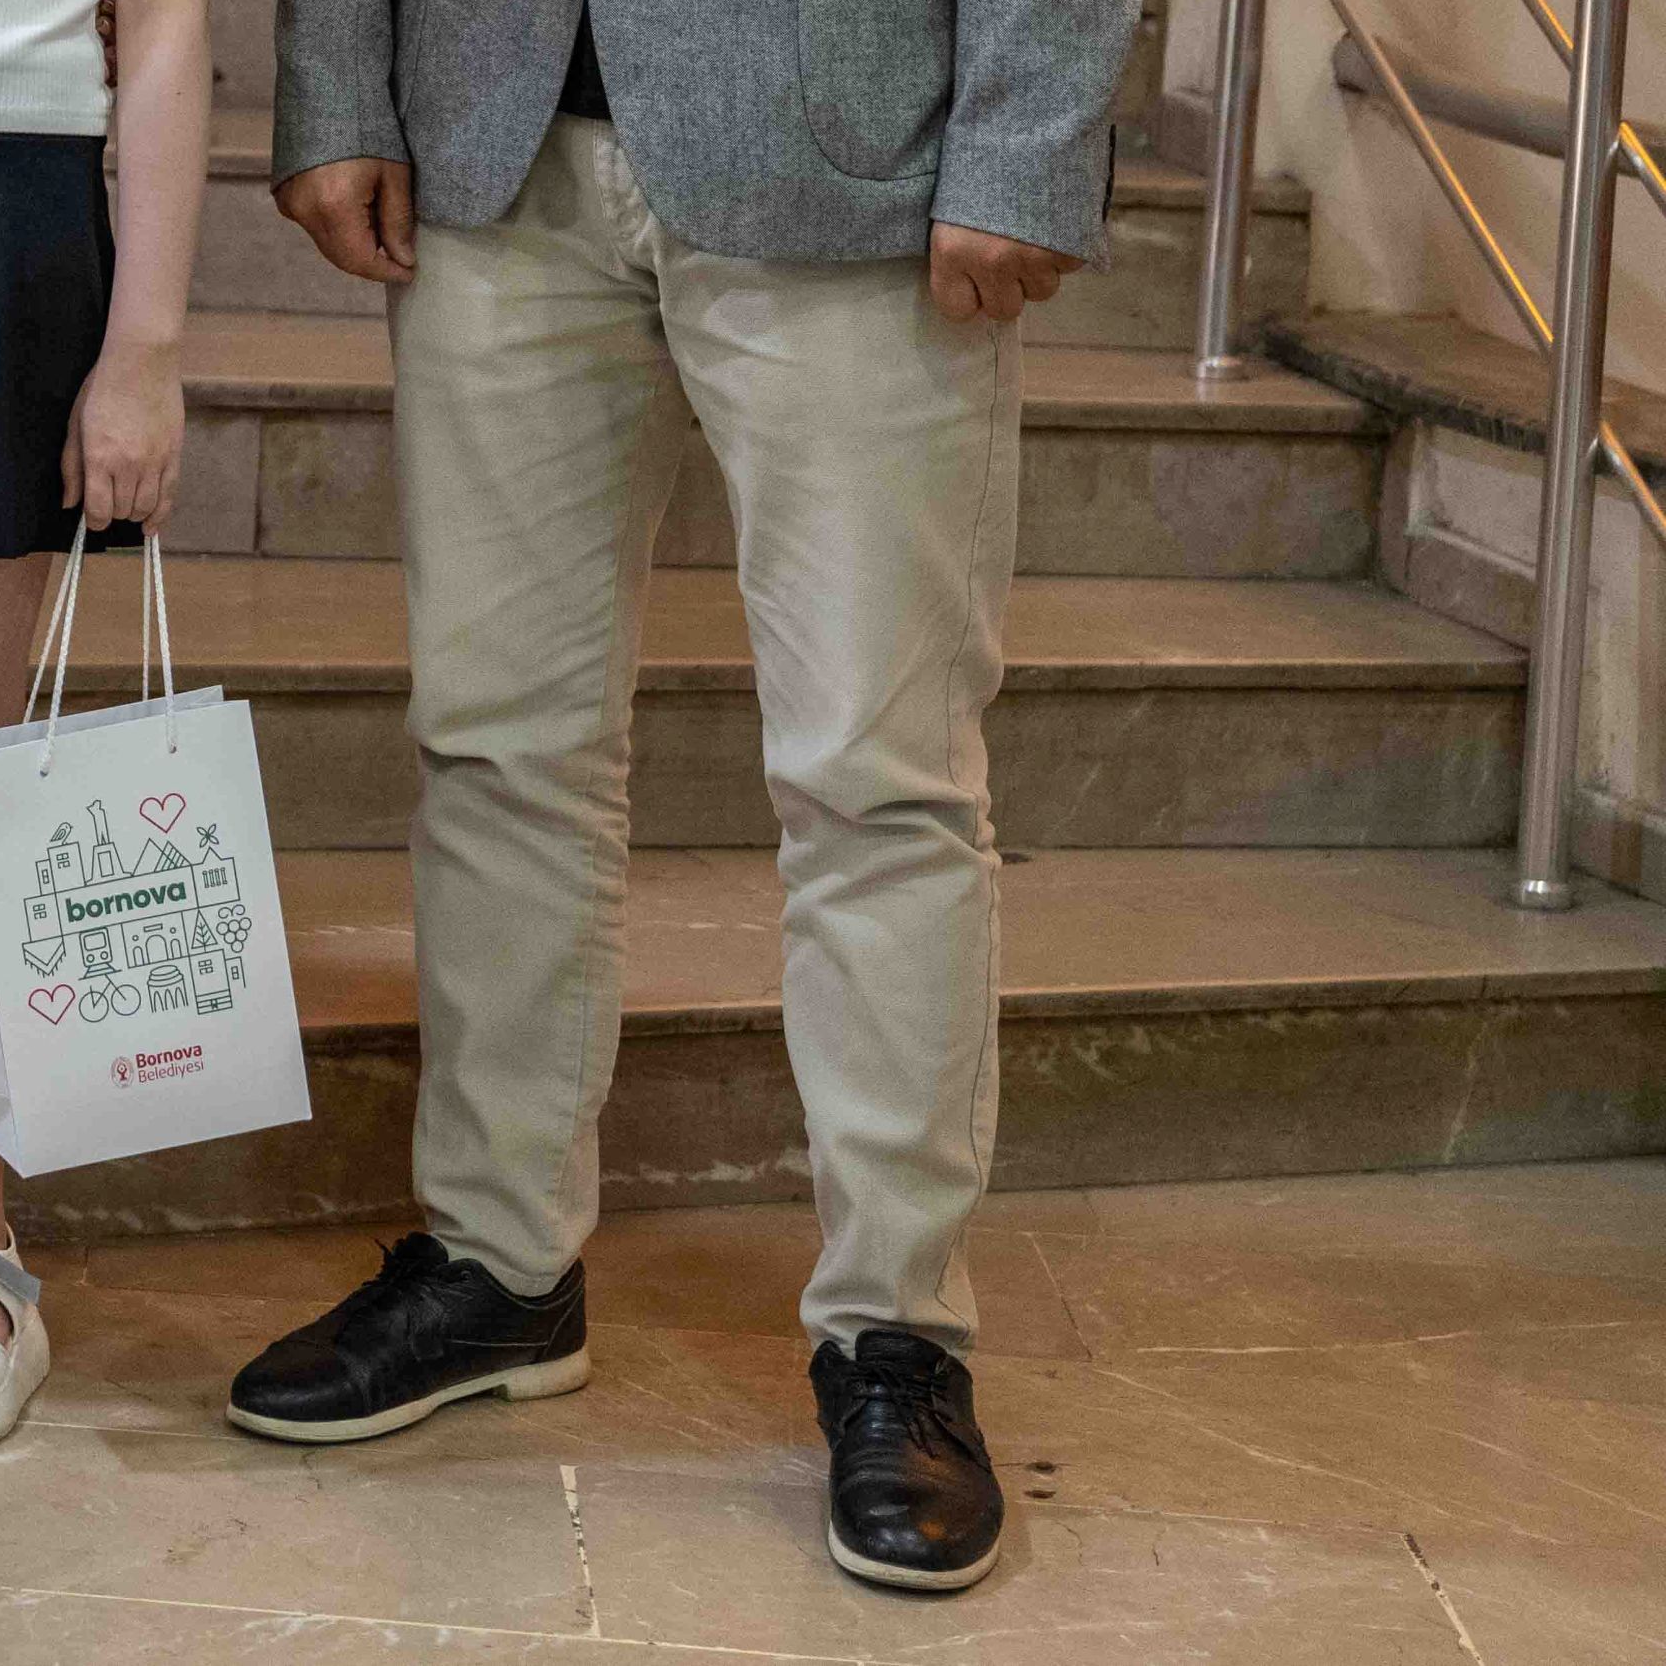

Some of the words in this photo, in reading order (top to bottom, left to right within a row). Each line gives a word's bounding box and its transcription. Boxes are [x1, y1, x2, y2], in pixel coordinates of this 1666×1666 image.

[65, 881, 187, 923] bornova
[135, 1044, 203, 1069] Bornova
[138, 1058, 205, 1083] Belediyesi
